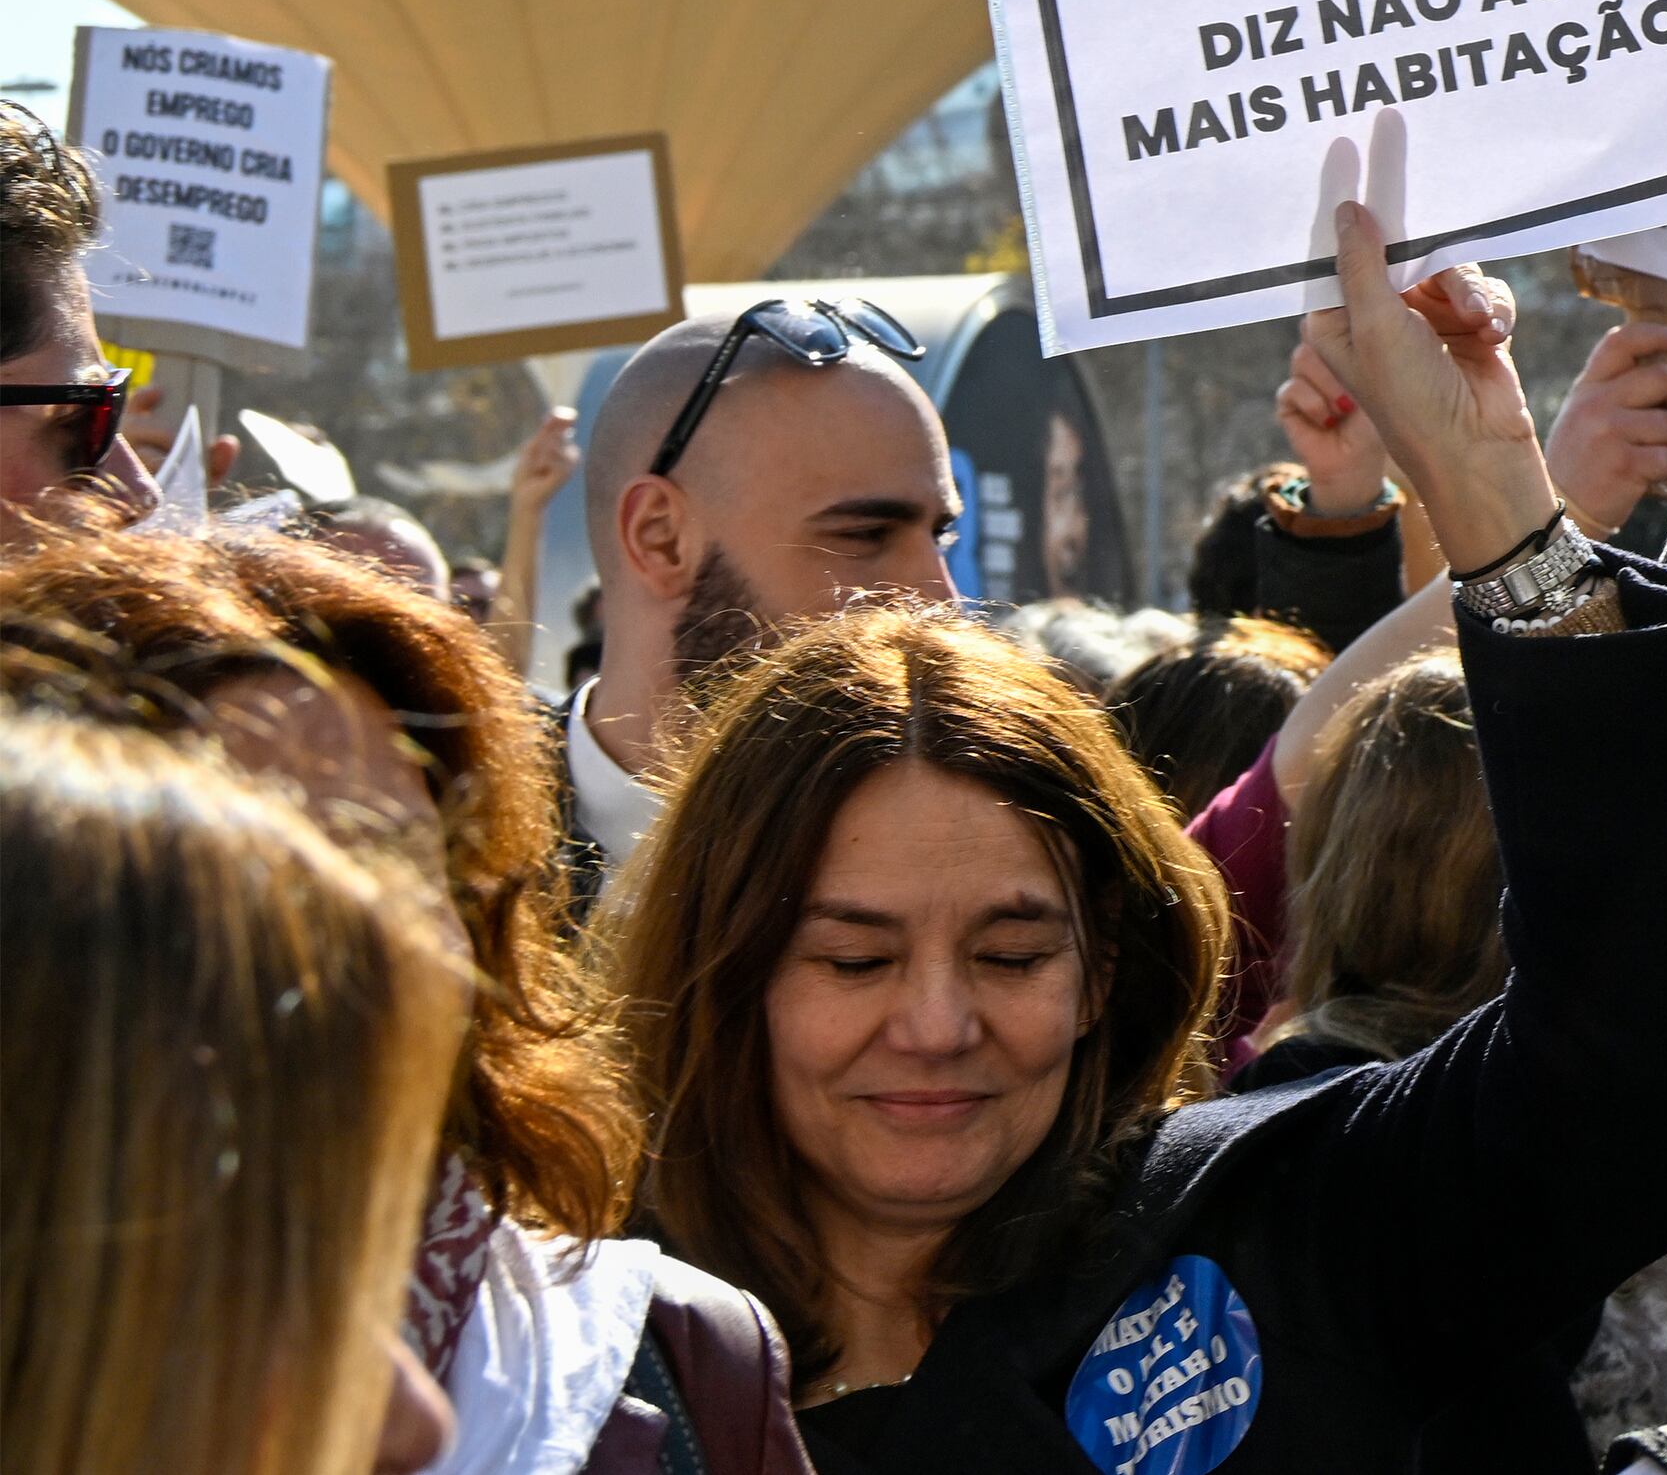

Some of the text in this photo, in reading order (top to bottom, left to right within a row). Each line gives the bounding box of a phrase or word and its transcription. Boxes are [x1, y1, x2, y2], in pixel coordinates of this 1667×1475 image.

[1198, 6, 1304, 71] DIZ
[122, 44, 283, 92] NÓS CRIAMOS
[146, 89, 255, 131] EMPREGO
[1121, 85, 1287, 161] MAIS
[103, 129, 293, 184] O GOVERNO CRIA
[116, 174, 269, 225] DESEMPREGO
[1107, 1368, 1135, 1394] O
